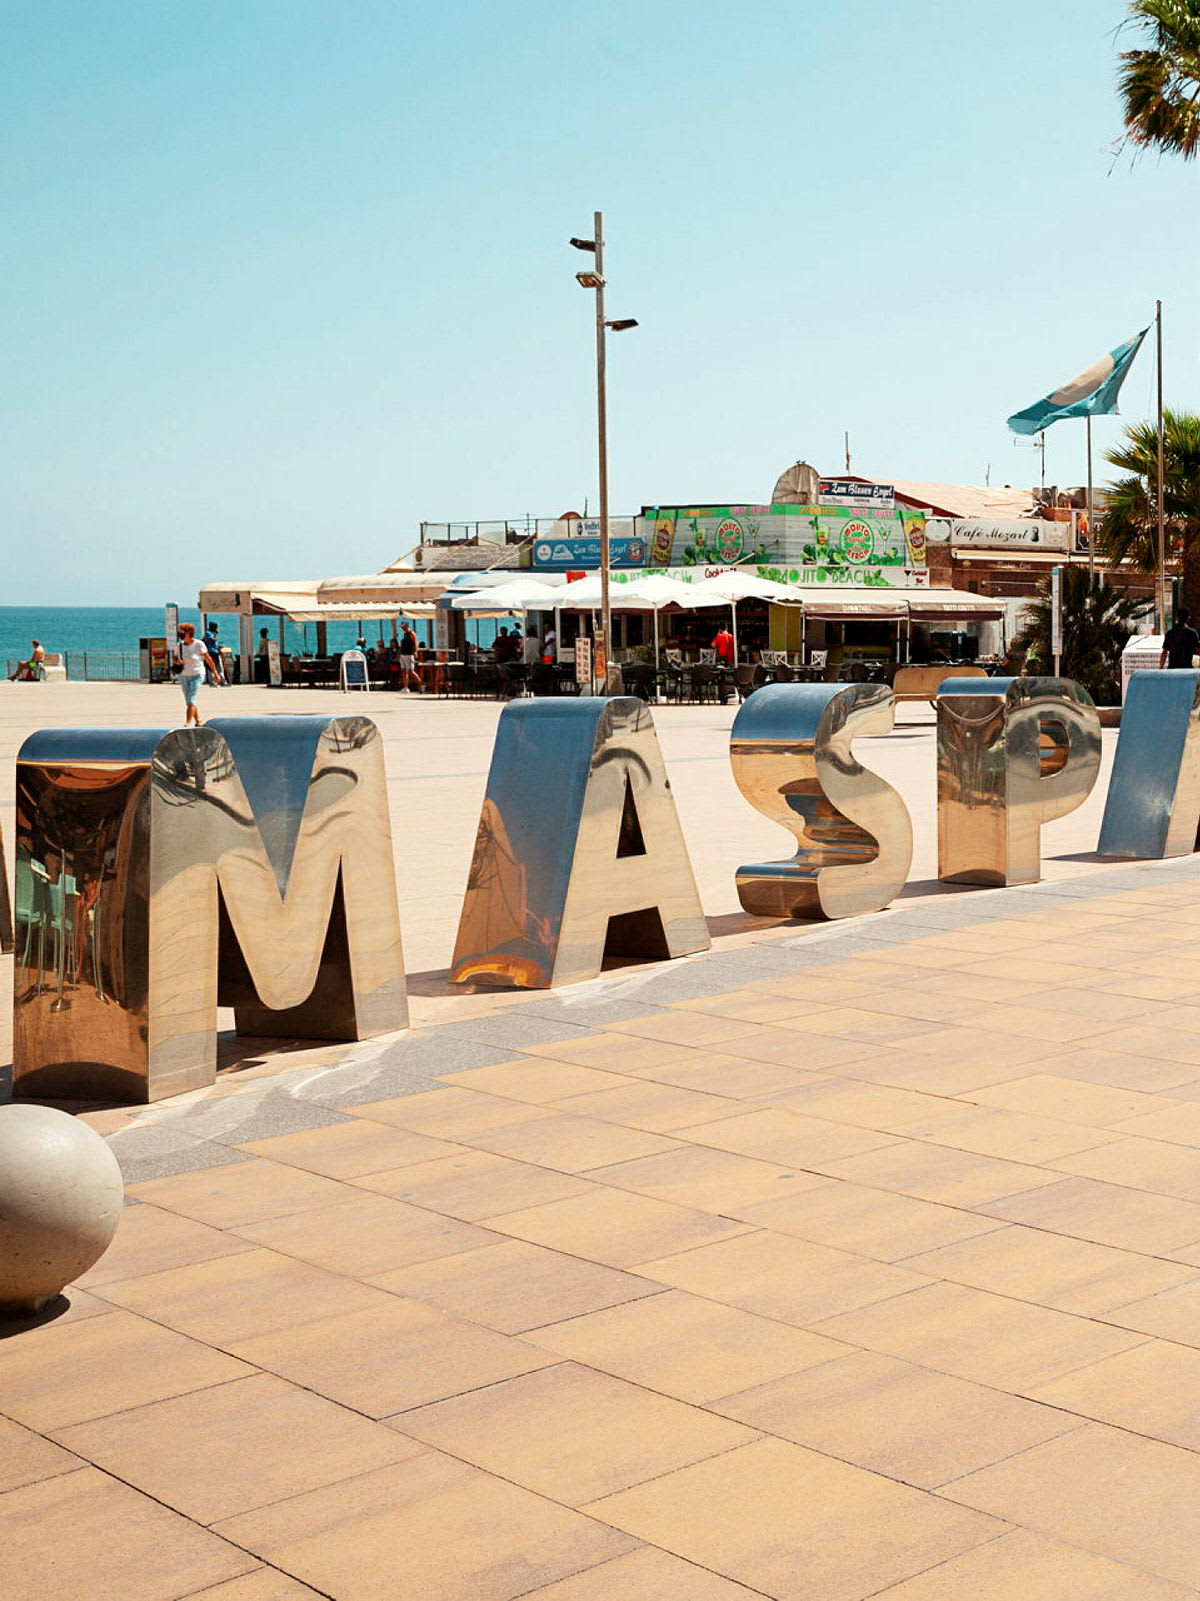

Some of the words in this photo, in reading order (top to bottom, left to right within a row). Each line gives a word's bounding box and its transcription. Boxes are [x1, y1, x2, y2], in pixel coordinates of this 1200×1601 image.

[844, 523, 870, 537] MOJITO
[985, 527, 1028, 542] Mozart
[831, 569, 869, 584] BEACH
